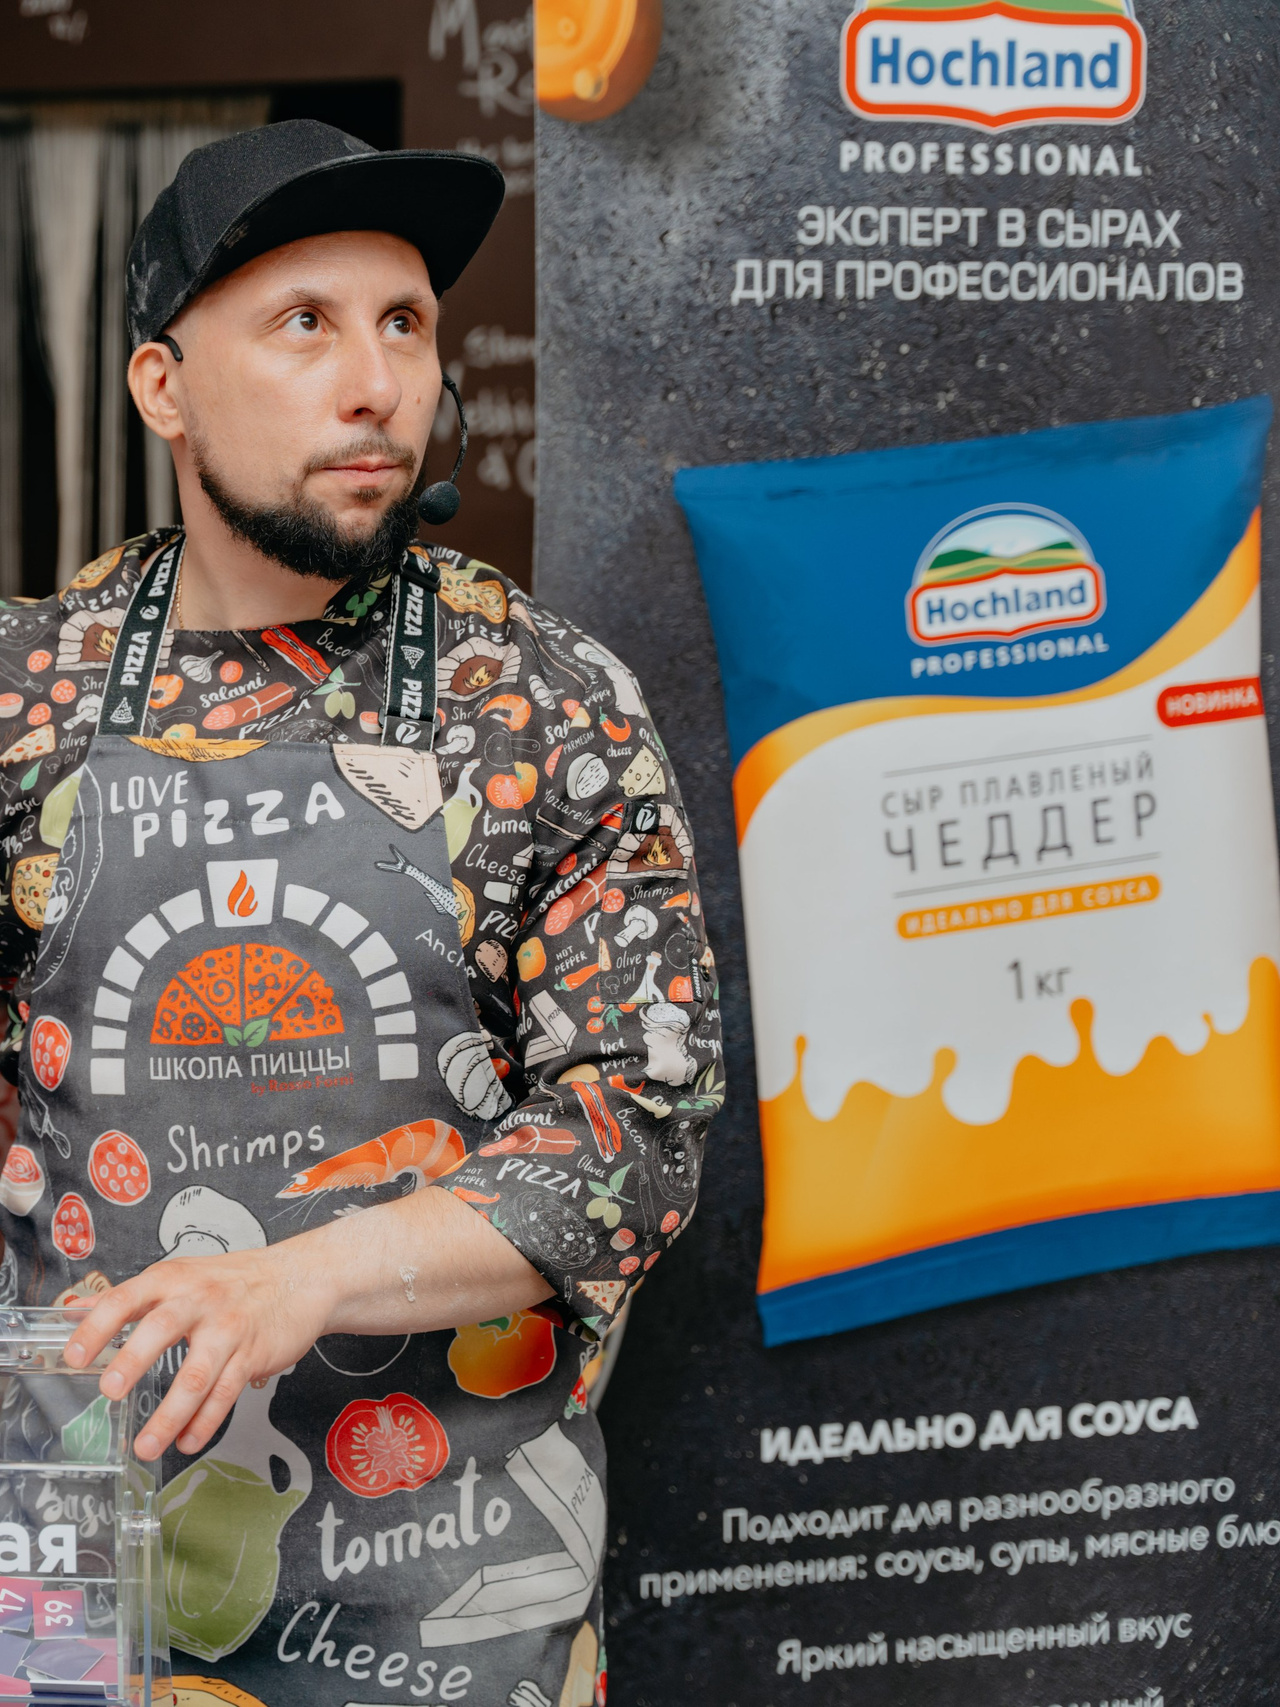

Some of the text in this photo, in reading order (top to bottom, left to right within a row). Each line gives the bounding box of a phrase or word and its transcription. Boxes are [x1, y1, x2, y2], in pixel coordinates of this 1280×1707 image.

[869, 36, 1120, 90] Hochland
[839, 140, 1144, 178] PROFESSIONAL
[796, 205, 1182, 249] ЭКСПЕРТ В СЫРАХ
[730, 259, 1244, 306] ДЛЯ ПРОФЕССИОНАЛОВ
[148, 546, 178, 597] PIZZA
[404, 582, 424, 636] PIZZA
[448, 613, 475, 631] LOVE
[925, 579, 1088, 628] Hochland
[120, 631, 152, 686] PIZZA
[910, 633, 1110, 678] PROFESSIONAL
[199, 672, 267, 708] salami
[401, 678, 423, 719] PIZZ
[1165, 685, 1258, 719] НОВИНКА
[563, 730, 595, 755] PARMESAN
[438, 757, 460, 774] live
[881, 751, 1155, 819] СЫР ПЛАВЛЕНЫЙ
[110, 770, 189, 814] LOVE
[133, 781, 346, 858] PIZZA
[483, 809, 532, 838] toma
[884, 791, 1158, 873] ЧЕДДЕР
[465, 843, 527, 886] Cheese
[630, 884, 674, 901] Shrimps
[905, 880, 1152, 937] ИДЕАЛЬНО ДЛЯ СОУСА
[554, 950, 588, 975] PEPPER
[556, 946, 573, 961] HOT
[616, 951, 642, 969] olive
[623, 970, 636, 985] oil
[1007, 958, 1025, 1001] 1
[149, 1046, 350, 1080] ШКОЛА ПИЦЦЫ
[251, 1073, 354, 1097] by Rosso Forni
[494, 1107, 558, 1139] salami
[616, 1107, 647, 1156] Bacon
[167, 1124, 325, 1174] Shrimps
[454, 1174, 487, 1188] PEPPER
[464, 1167, 482, 1176] HOT
[760, 1396, 1198, 1467] ИДЕАЛЬНО ДЛЯ СОУСА
[570, 1467, 595, 1515] PIZZA
[722, 1477, 1236, 1545] Подходит для разнообразного
[316, 1457, 512, 1581] tomato
[639, 1555, 867, 1607] применения:
[875, 1546, 984, 1584] соусы,
[990, 1536, 1079, 1575] супы,
[1084, 1524, 1210, 1561] мясные
[44, 1600, 74, 1628] 39
[276, 1602, 472, 1701] Cheese
[776, 1611, 1192, 1682] Яркий насыщенный вкус
